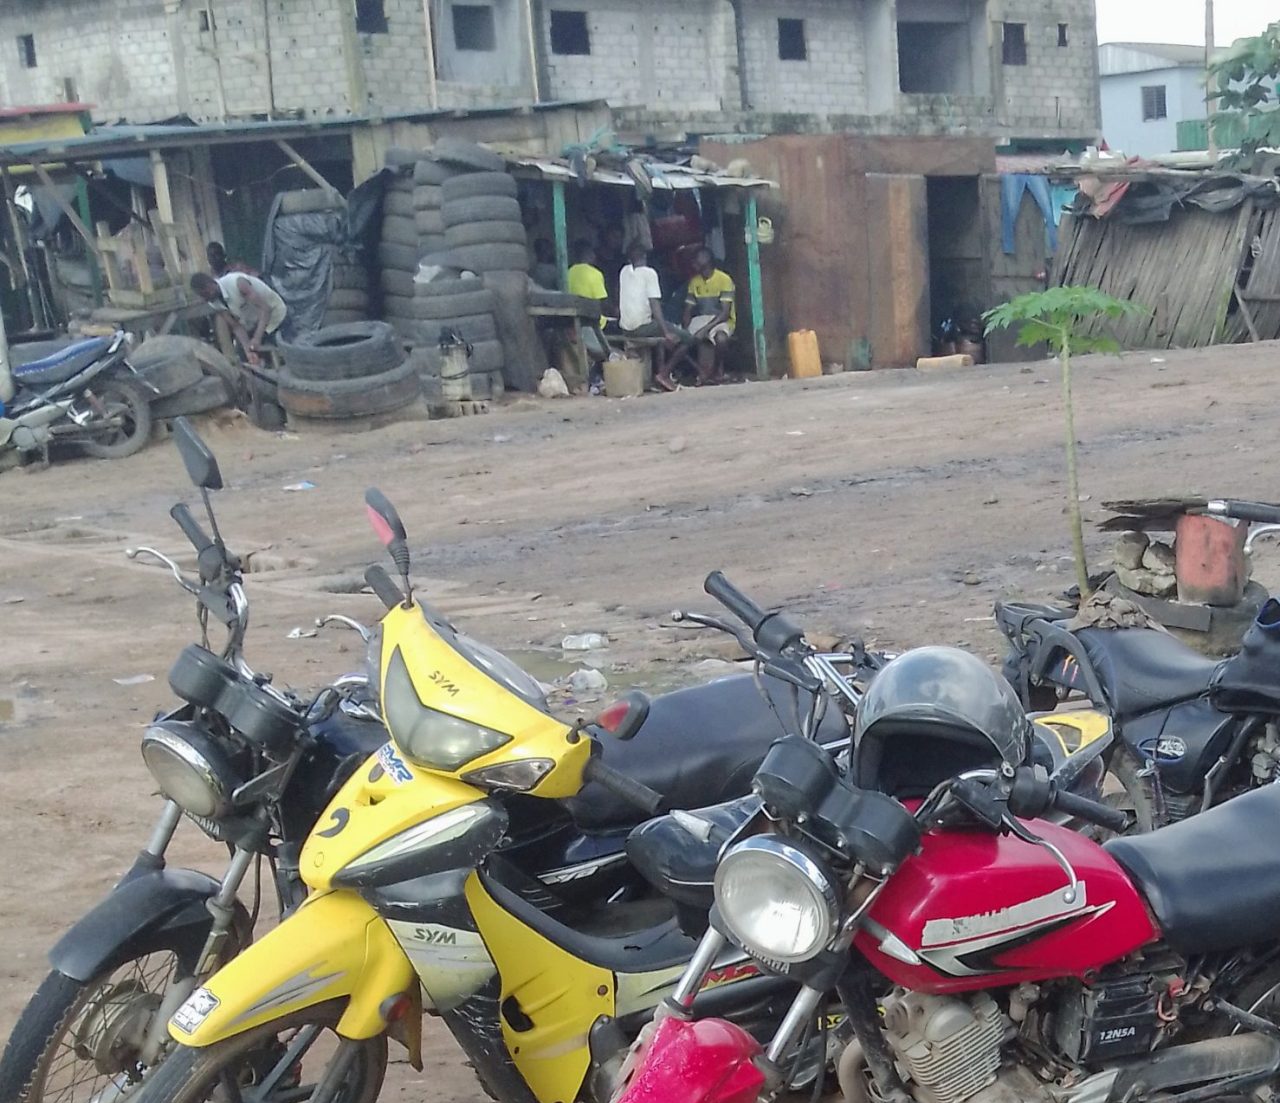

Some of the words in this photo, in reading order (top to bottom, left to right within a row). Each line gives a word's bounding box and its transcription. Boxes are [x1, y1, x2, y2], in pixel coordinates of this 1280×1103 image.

[428, 670, 460, 697] SYM
[183, 808, 220, 837] MAHA
[414, 928, 456, 945] SYM
[741, 942, 790, 975] MAHA
